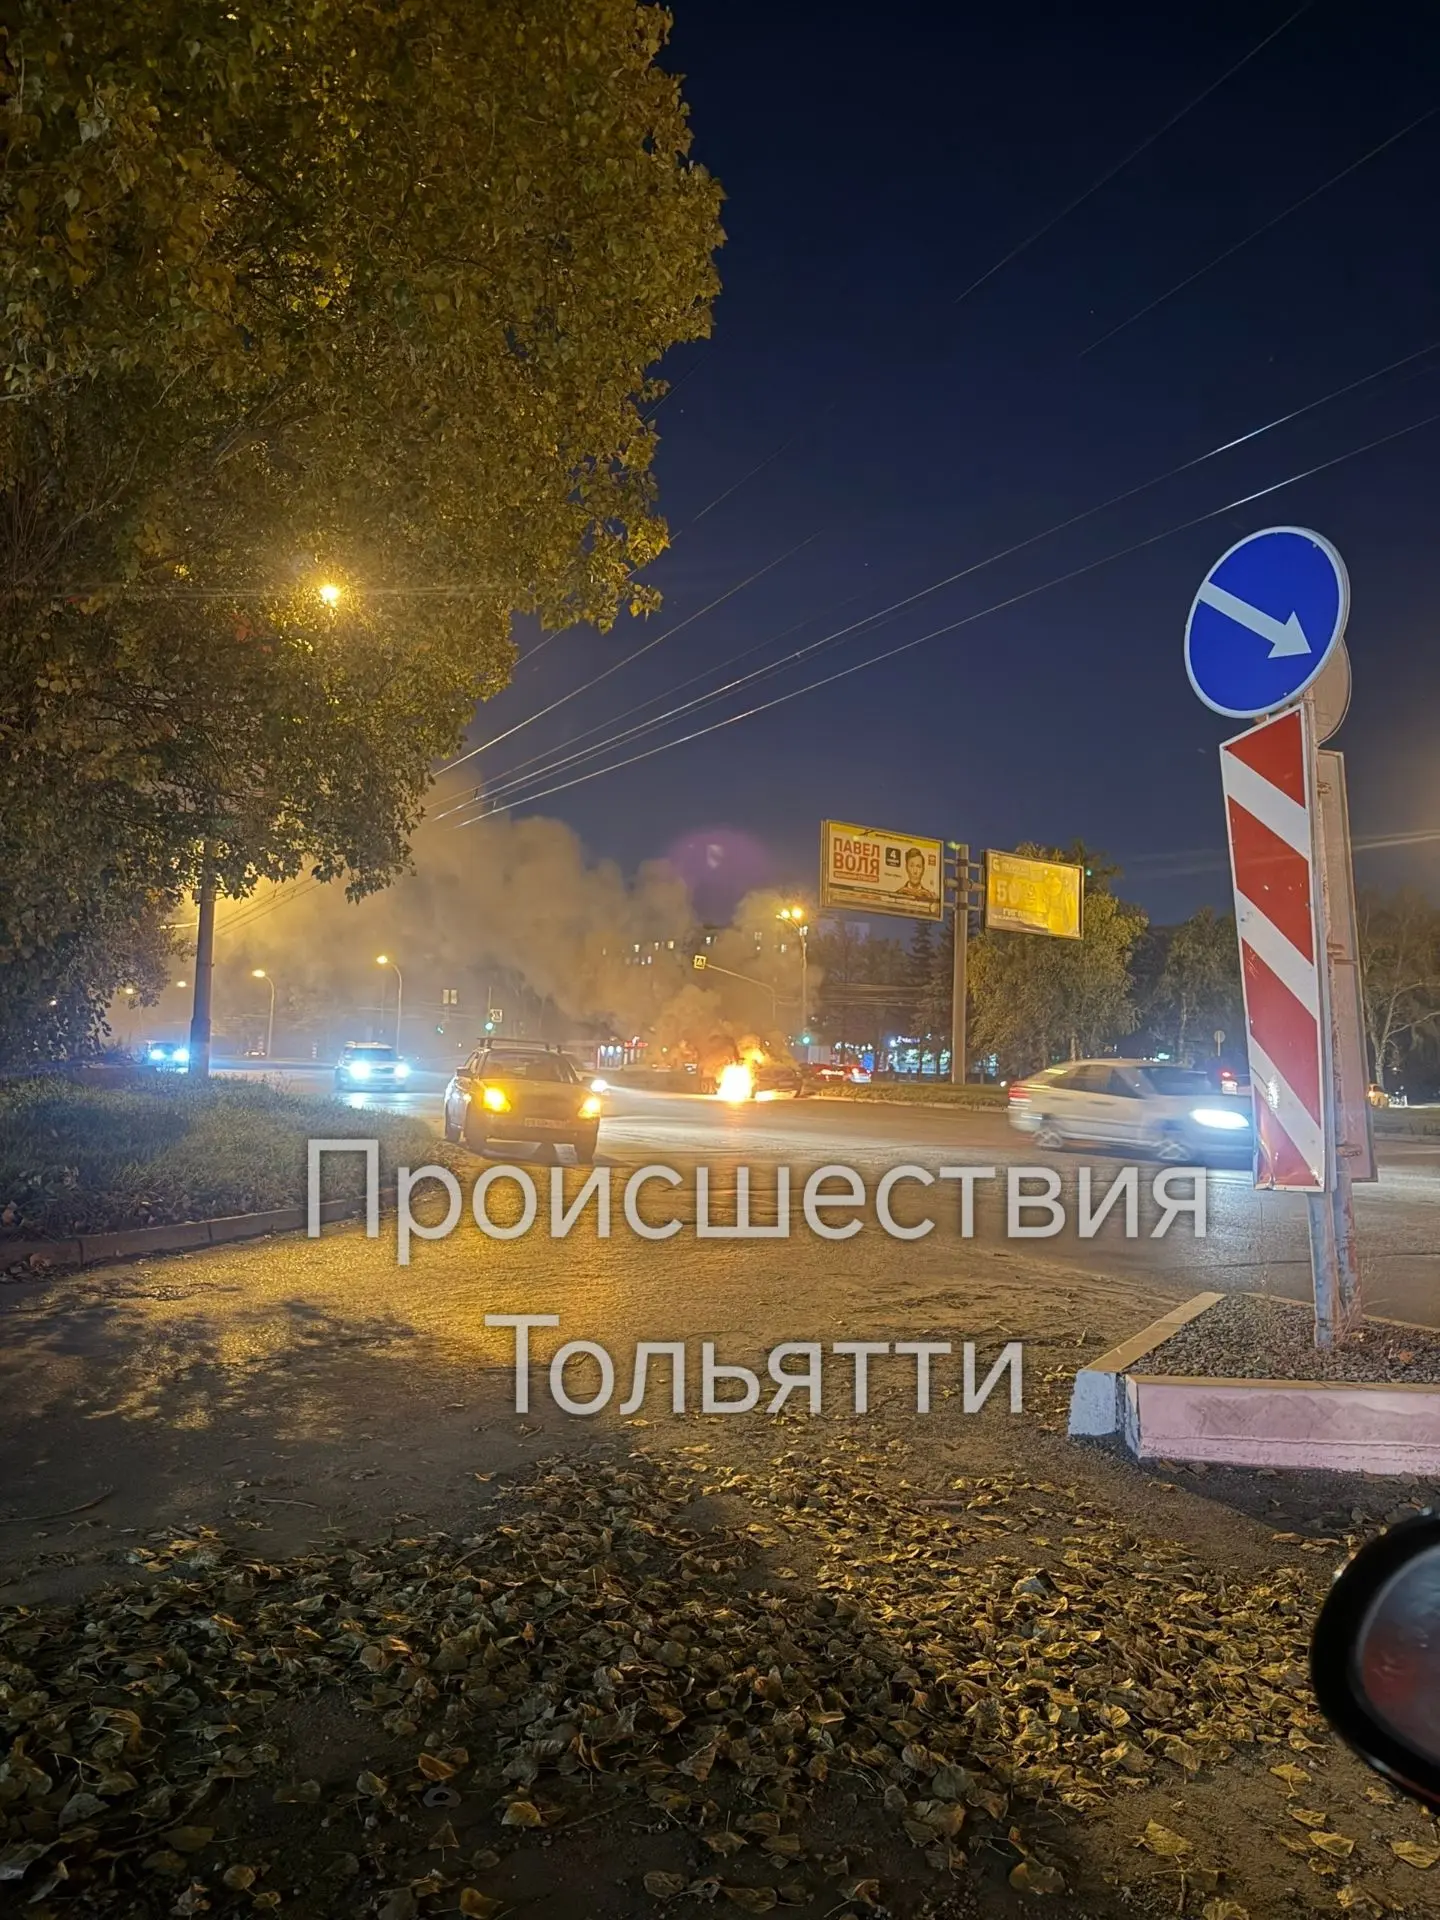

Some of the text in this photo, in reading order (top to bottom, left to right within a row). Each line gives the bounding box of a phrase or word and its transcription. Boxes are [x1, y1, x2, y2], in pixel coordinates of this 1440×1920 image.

[833, 837, 880, 858] ПАВЕЛ
[890, 849, 898, 859] 4
[833, 852, 880, 875] ВОЛЯ
